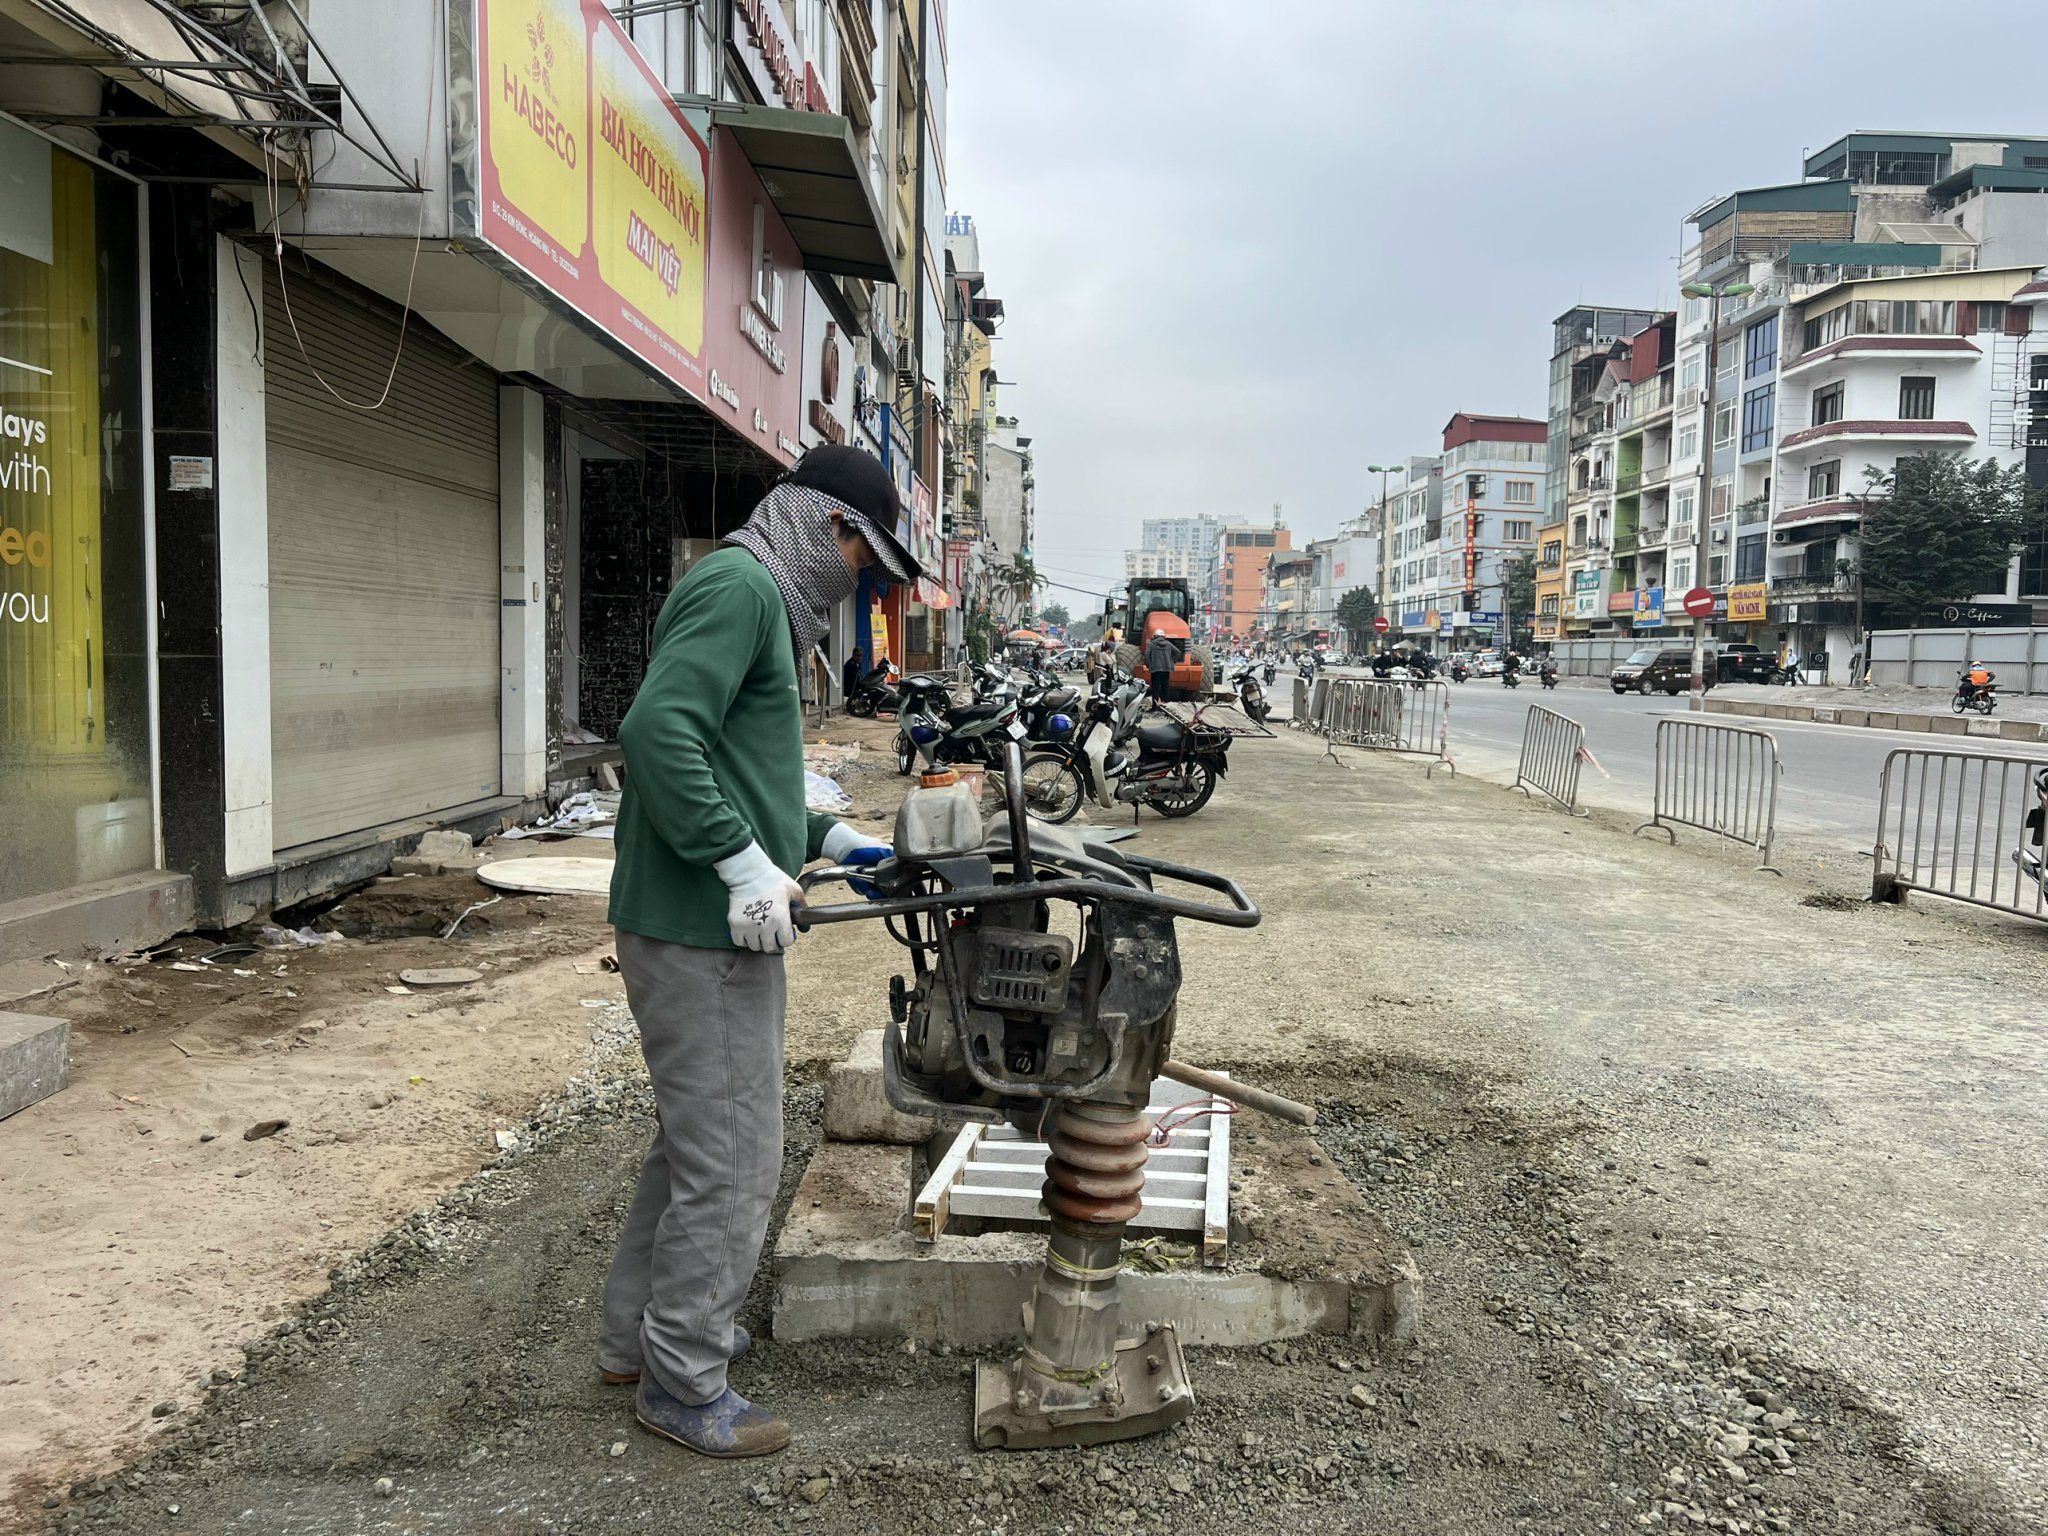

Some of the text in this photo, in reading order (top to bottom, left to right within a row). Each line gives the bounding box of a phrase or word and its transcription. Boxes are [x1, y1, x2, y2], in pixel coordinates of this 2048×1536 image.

[504, 63, 577, 170] HABECO
[600, 93, 628, 164] BIA
[658, 165, 677, 219] HÀ
[678, 189, 700, 247] NỘI
[628, 213, 681, 294] MAI VIỆT
[1967, 607, 2002, 622] Coffee
